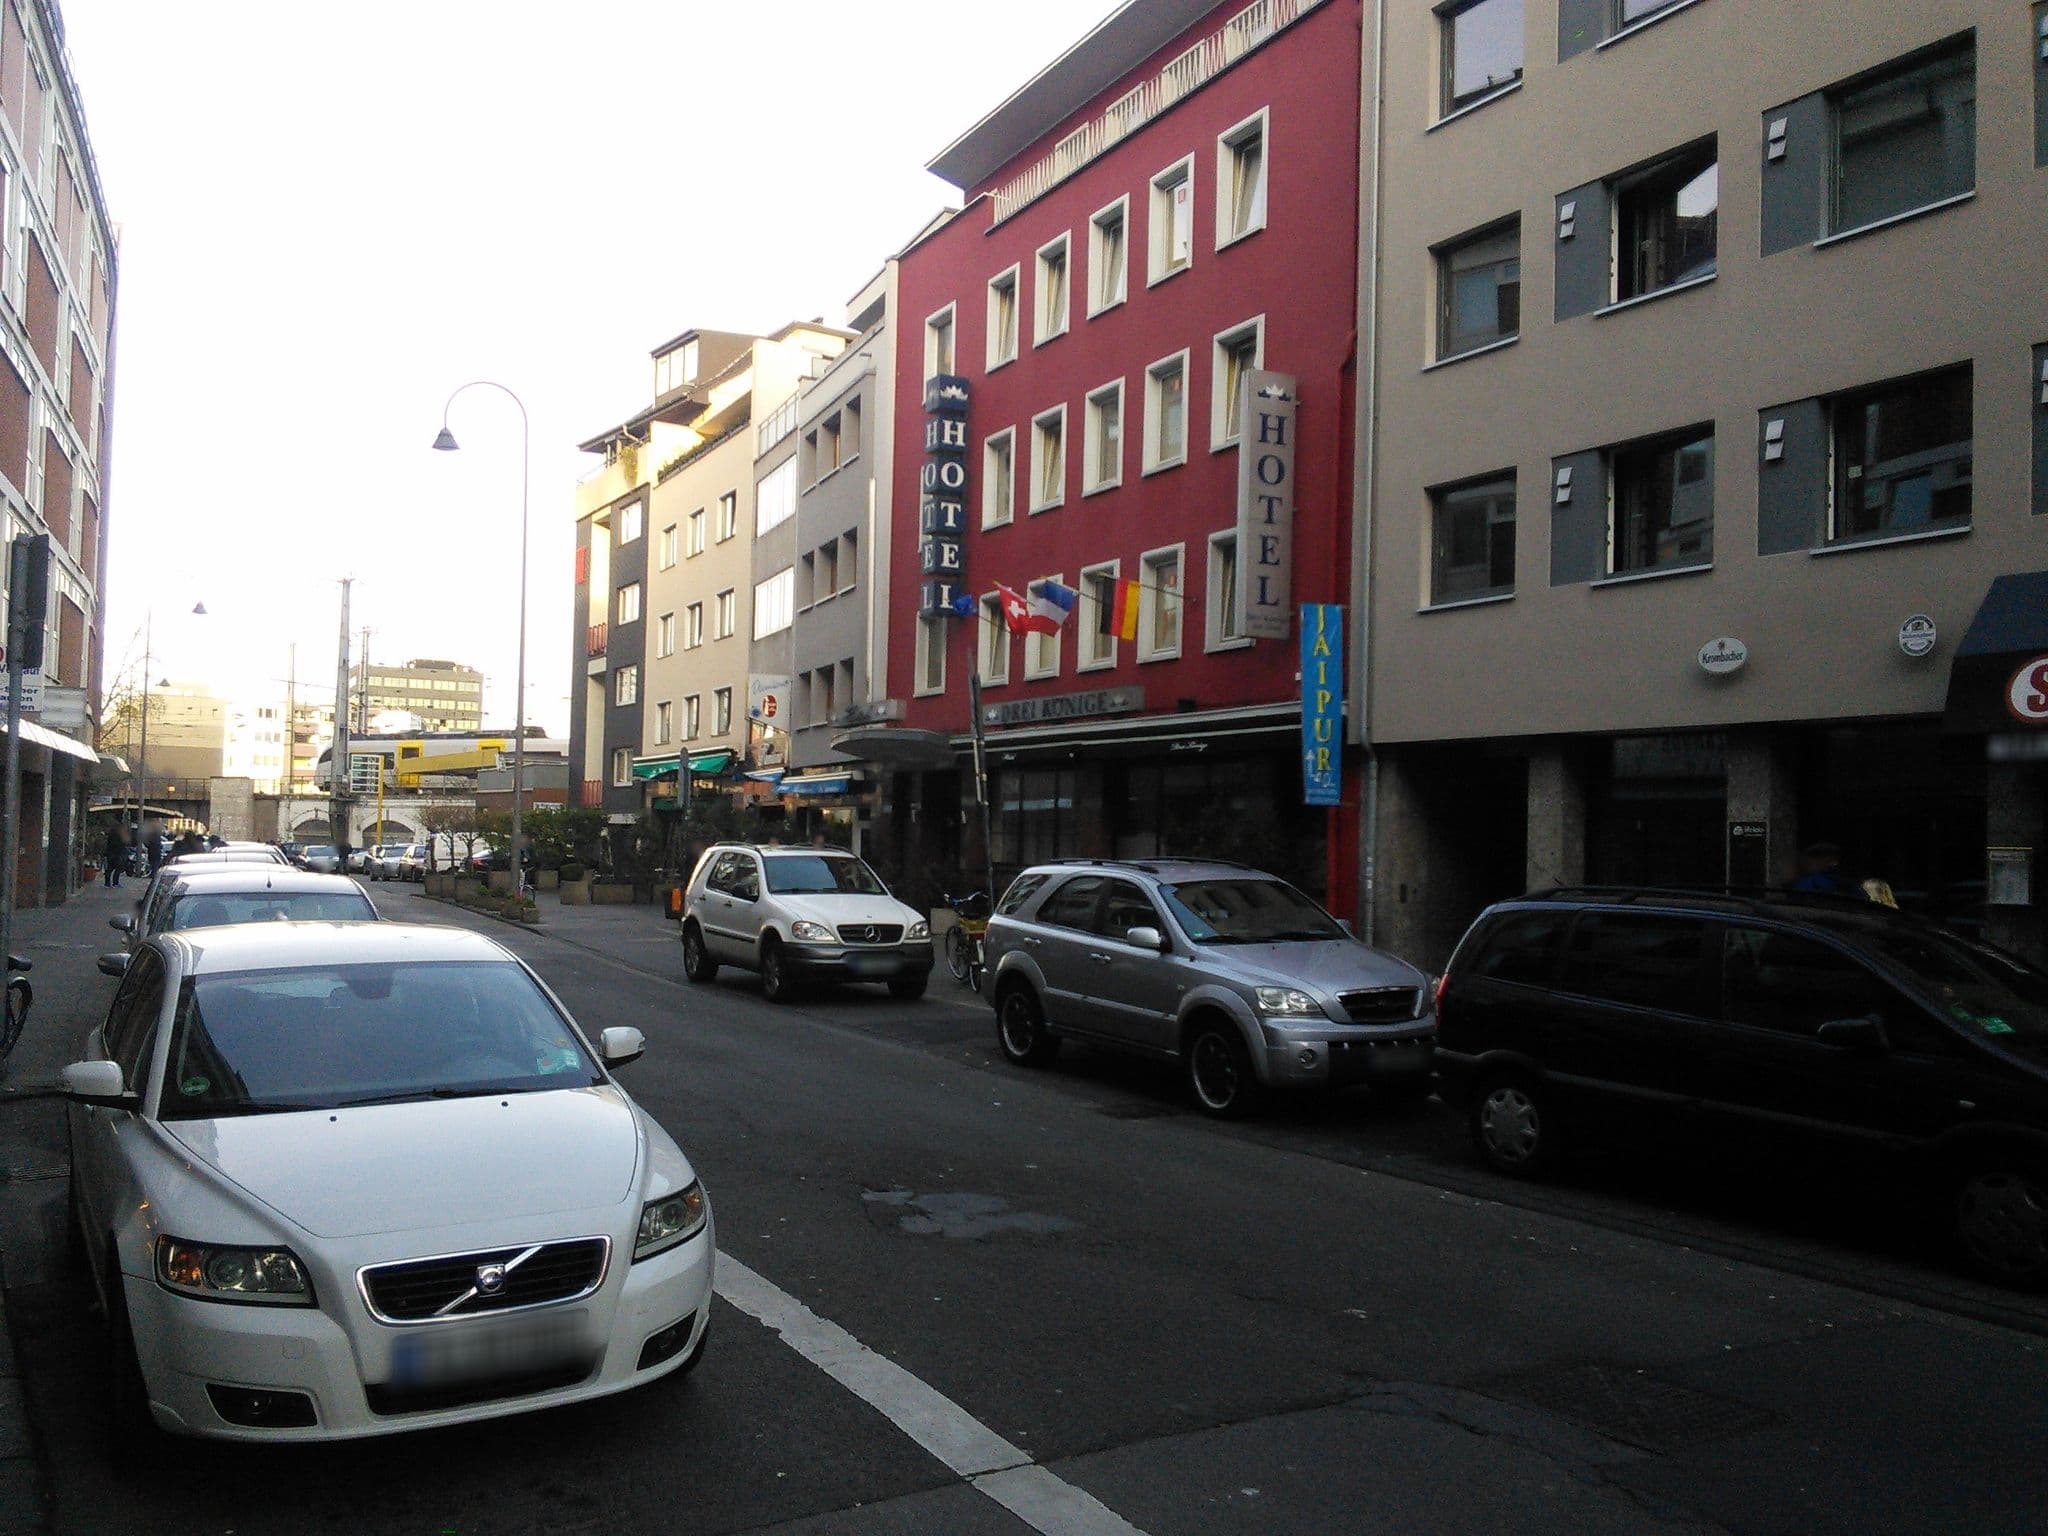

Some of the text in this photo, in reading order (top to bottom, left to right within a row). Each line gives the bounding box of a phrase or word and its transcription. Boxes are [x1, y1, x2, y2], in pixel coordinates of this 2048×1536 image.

[1257, 412, 1287, 606] HOTEL
[1312, 603, 1333, 771] JAIPUR
[1702, 650, 1743, 664] Krombacher
